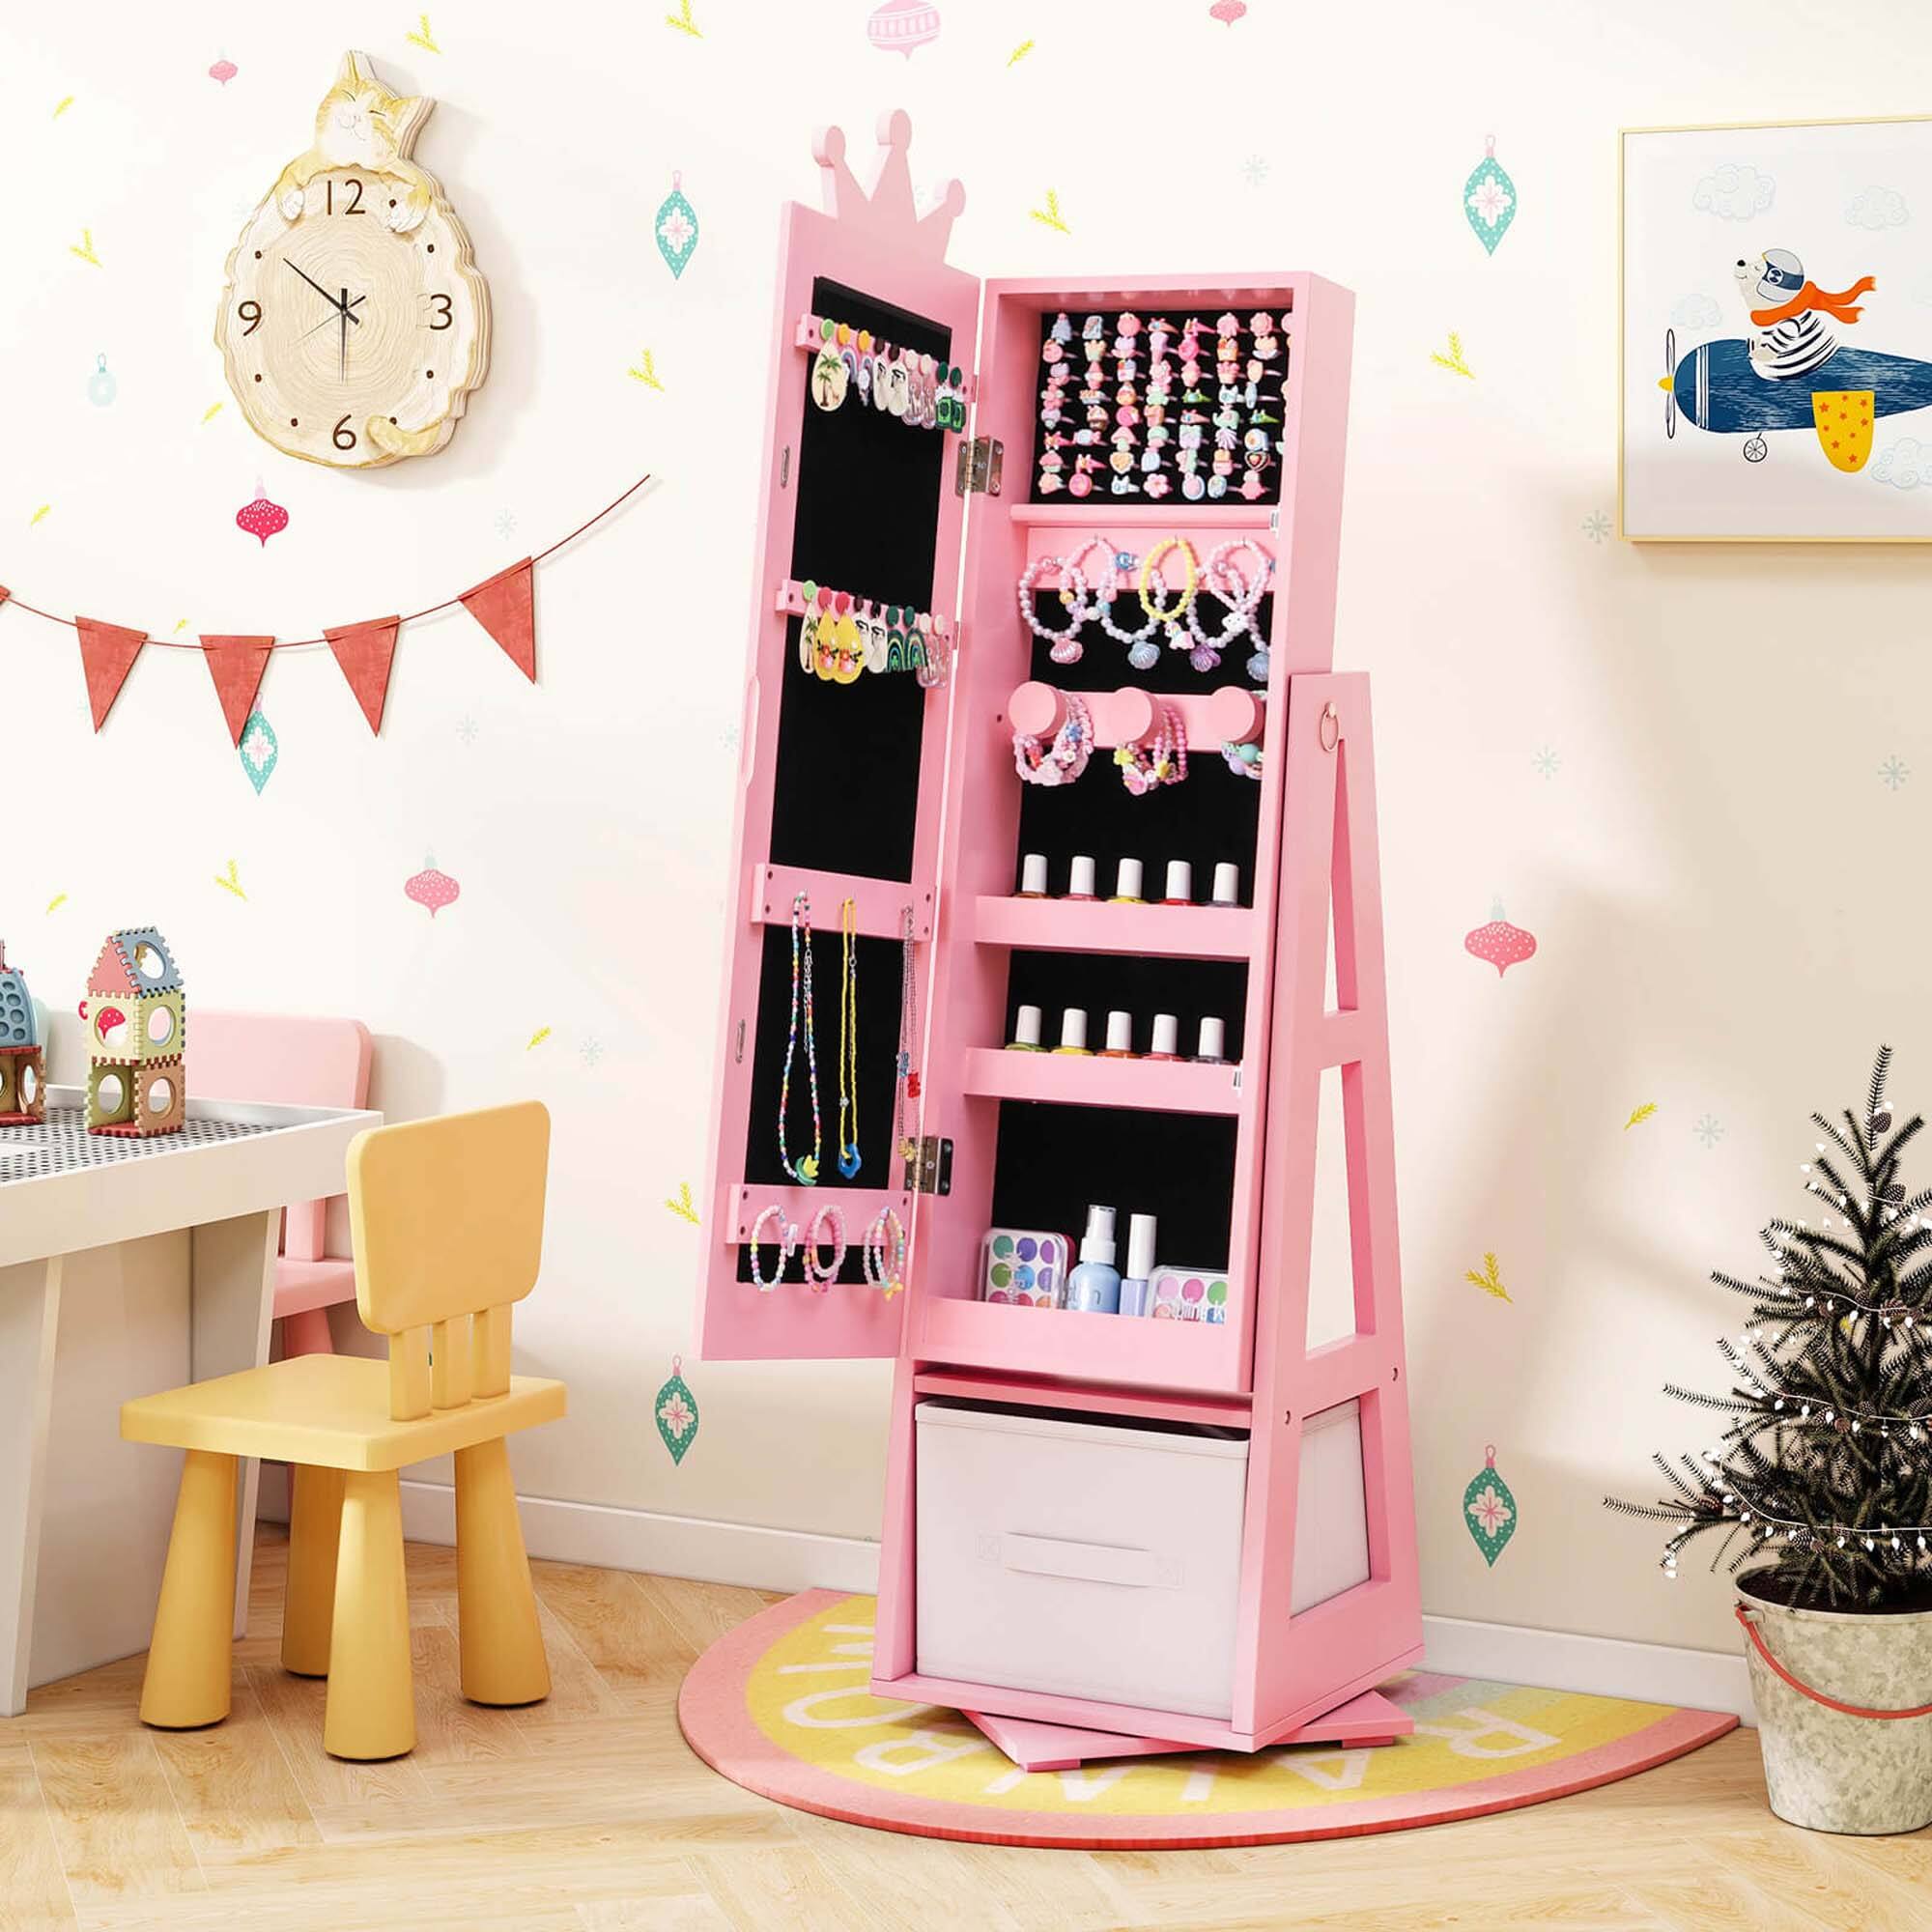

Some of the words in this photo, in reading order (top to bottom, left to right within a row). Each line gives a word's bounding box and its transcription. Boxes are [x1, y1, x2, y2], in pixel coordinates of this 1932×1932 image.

[327, 178, 366, 215] 12
[237, 300, 263, 336] 9
[429, 293, 454, 330] 3
[331, 413, 357, 451] 6
